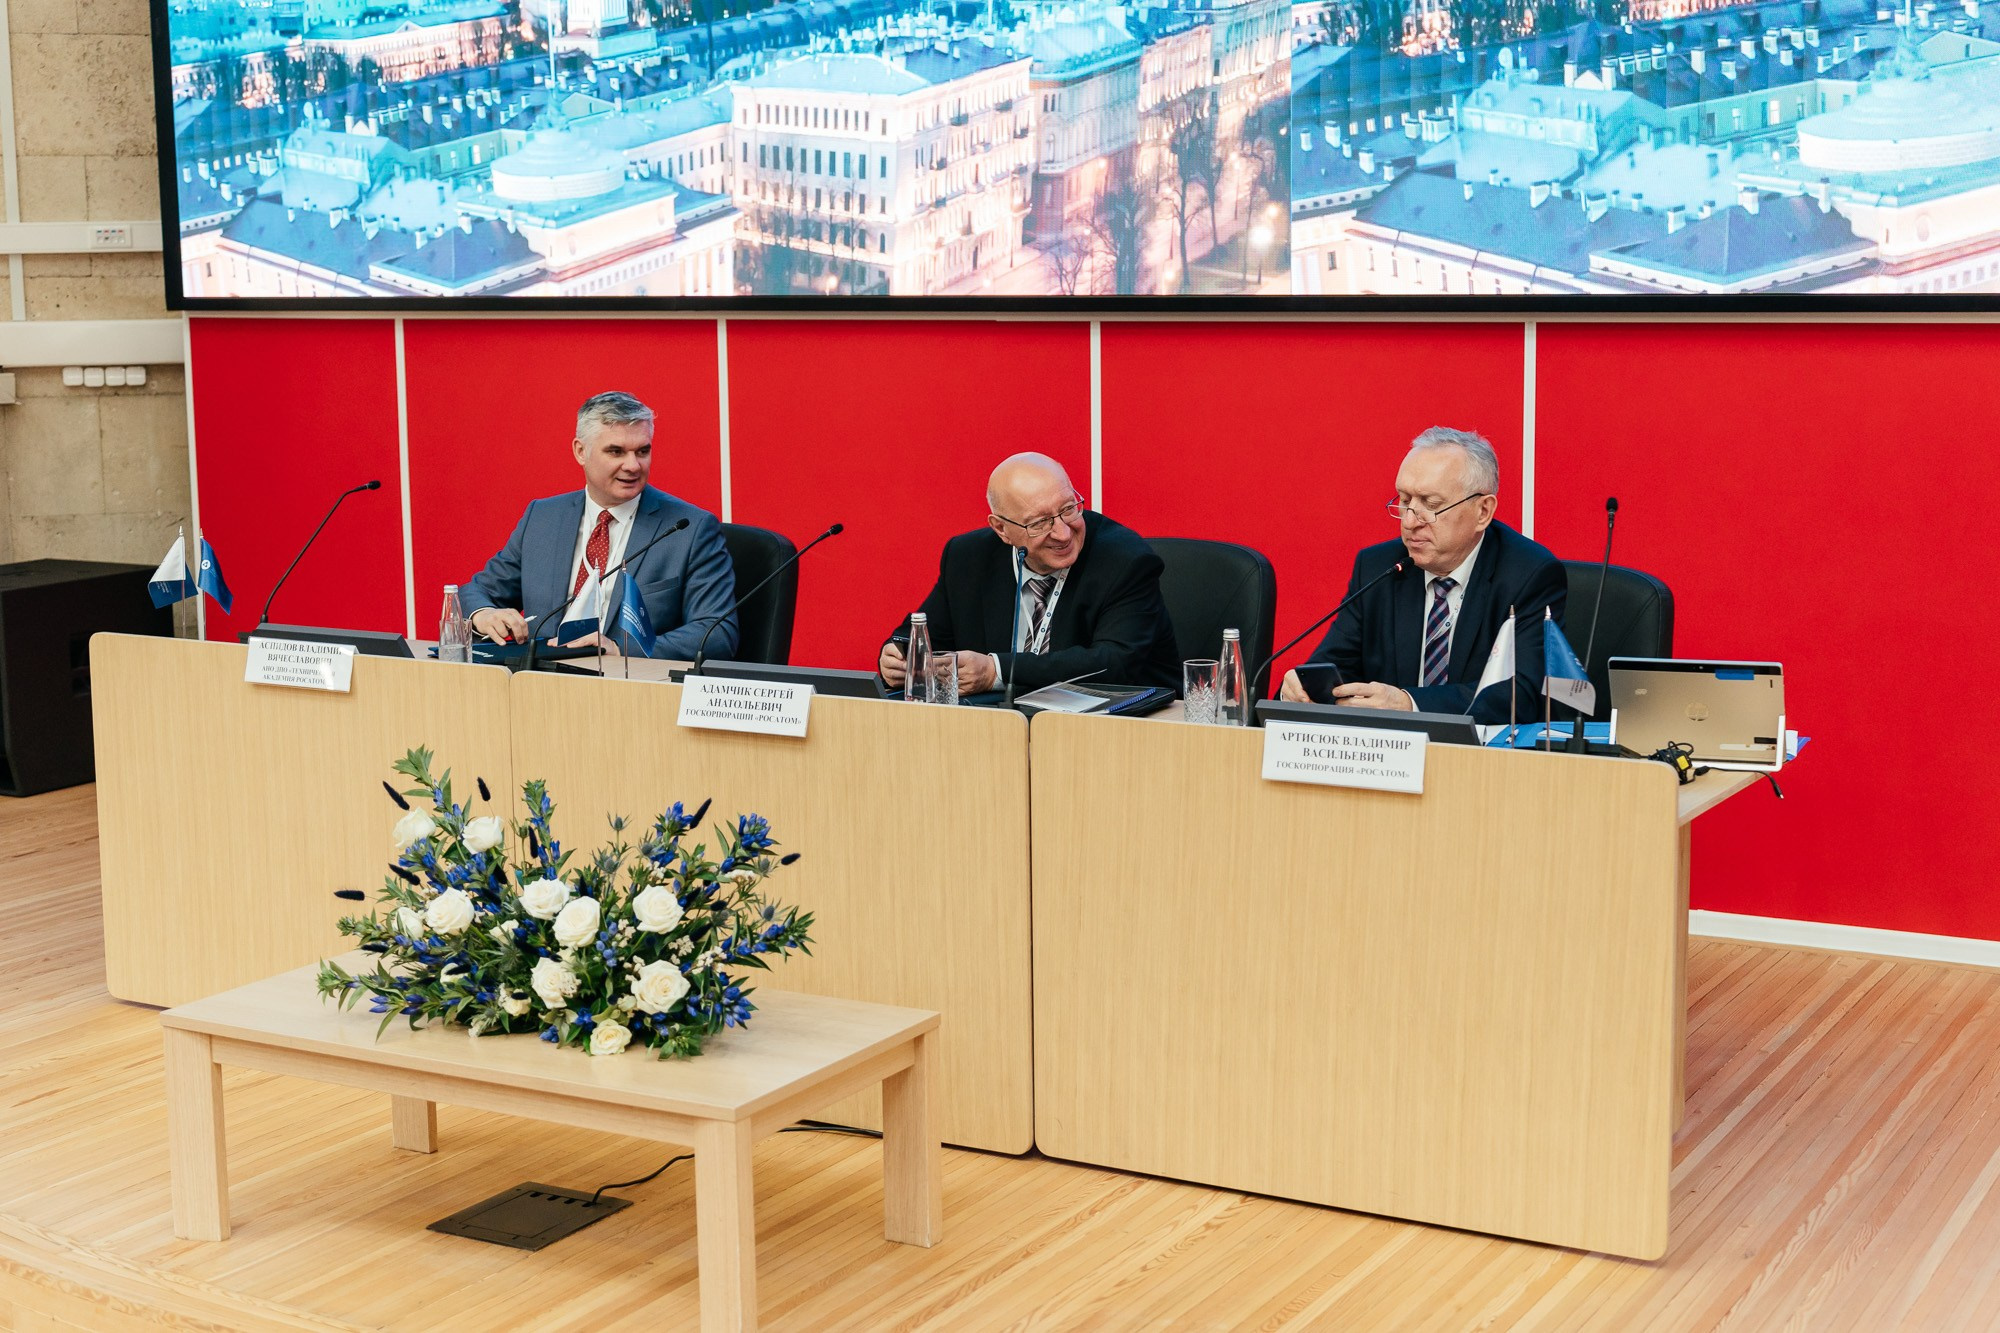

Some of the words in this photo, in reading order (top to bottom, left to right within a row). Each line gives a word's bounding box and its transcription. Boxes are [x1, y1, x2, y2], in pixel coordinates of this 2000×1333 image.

[700, 684, 752, 696] АДАМЧИК
[753, 687, 794, 700] СЕРГЕЙ
[706, 698, 782, 712] АНАТОЛЬЕВИЧ
[1280, 731, 1340, 746] АРТИСЮК
[1342, 735, 1411, 750] ВЛАДИМИР
[1302, 747, 1384, 763] ВАСИЛЬЕВИЧ
[1276, 760, 1354, 774] ГОСКОРПОРАЦИЯ
[1356, 767, 1410, 778] «РОСАТОМ»
